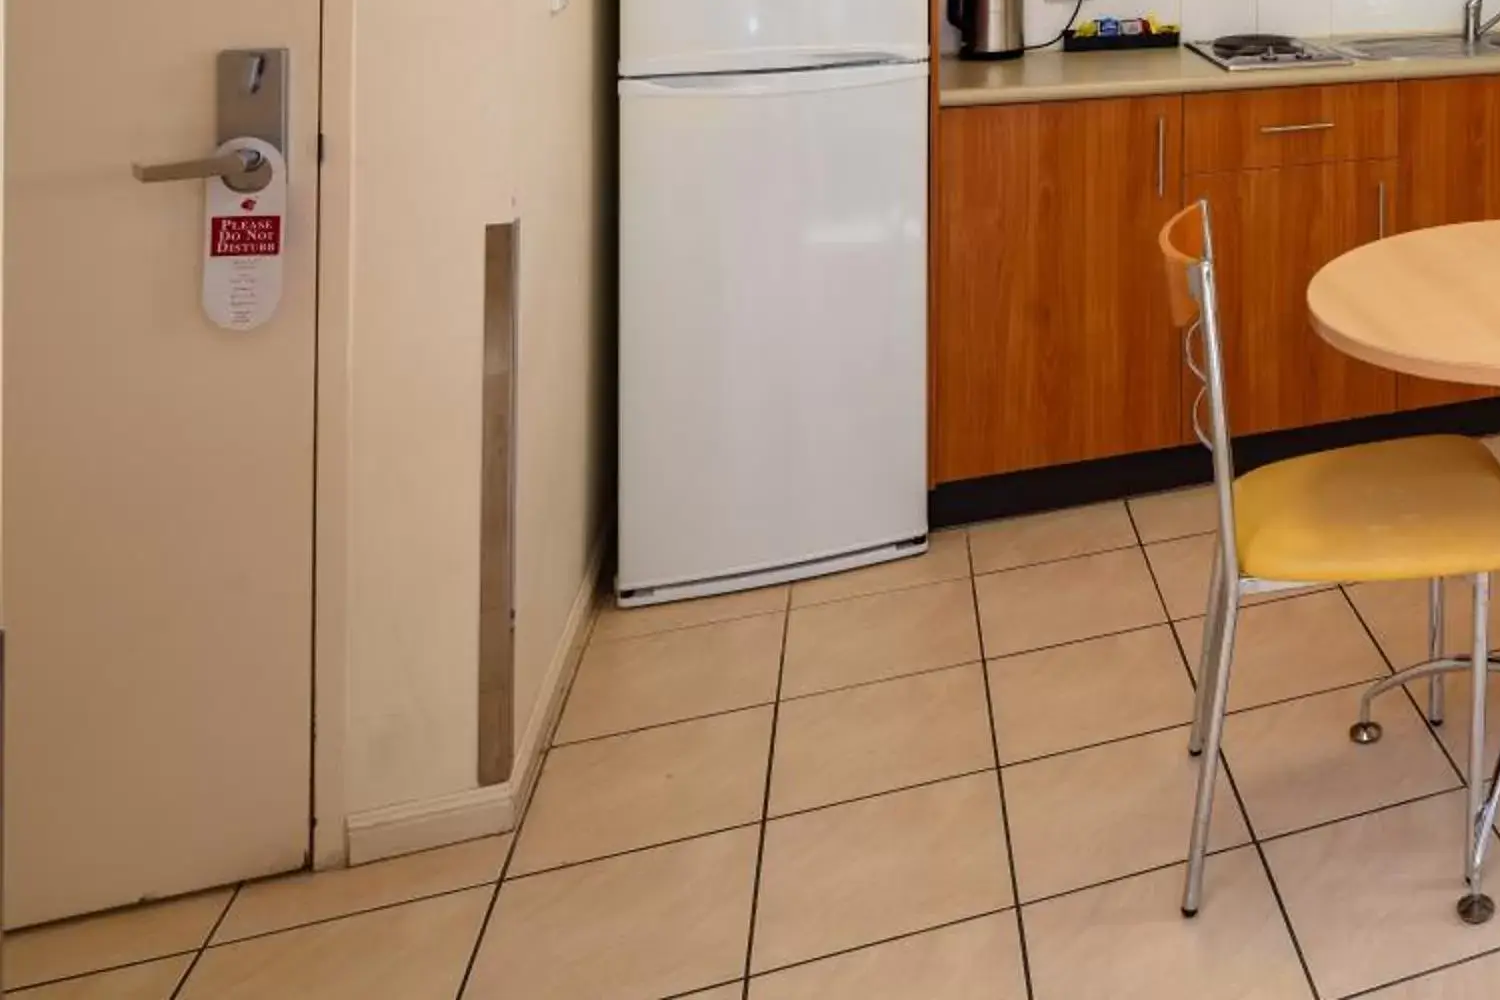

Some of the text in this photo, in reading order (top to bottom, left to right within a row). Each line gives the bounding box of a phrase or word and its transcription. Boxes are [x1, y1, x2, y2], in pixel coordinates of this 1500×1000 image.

[221, 219, 273, 231] PLEASE
[219, 230, 275, 243] DO NOT
[216, 243, 275, 253] DISTURB
